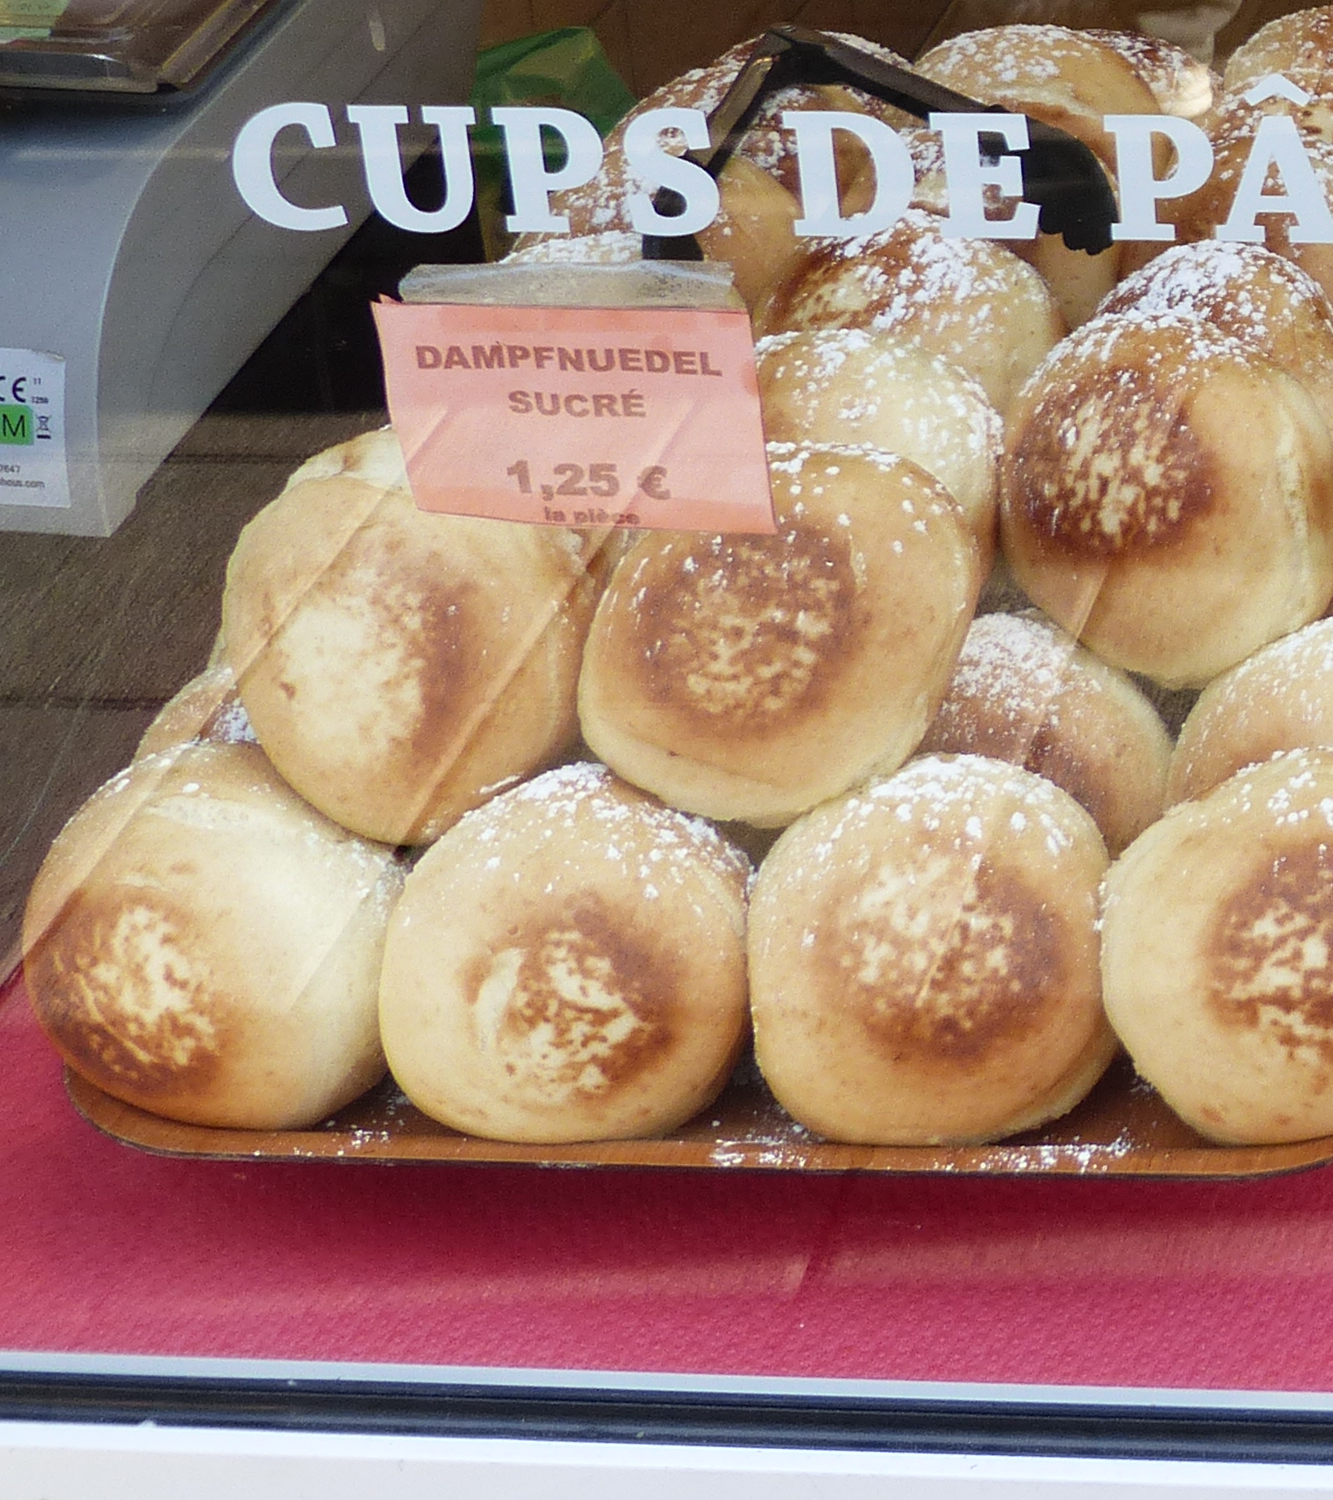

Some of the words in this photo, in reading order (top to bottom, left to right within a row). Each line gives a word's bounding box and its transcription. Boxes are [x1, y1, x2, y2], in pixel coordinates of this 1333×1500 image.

[232, 102, 721, 237] CUPS
[782, 111, 1042, 239] DE
[415, 344, 723, 377] DAMPFNUEDEL
[508, 388, 648, 418] SUCRÉ
[2, 413, 26, 438] M
[506, 459, 622, 501] 1,25
[637, 464, 671, 501] €
